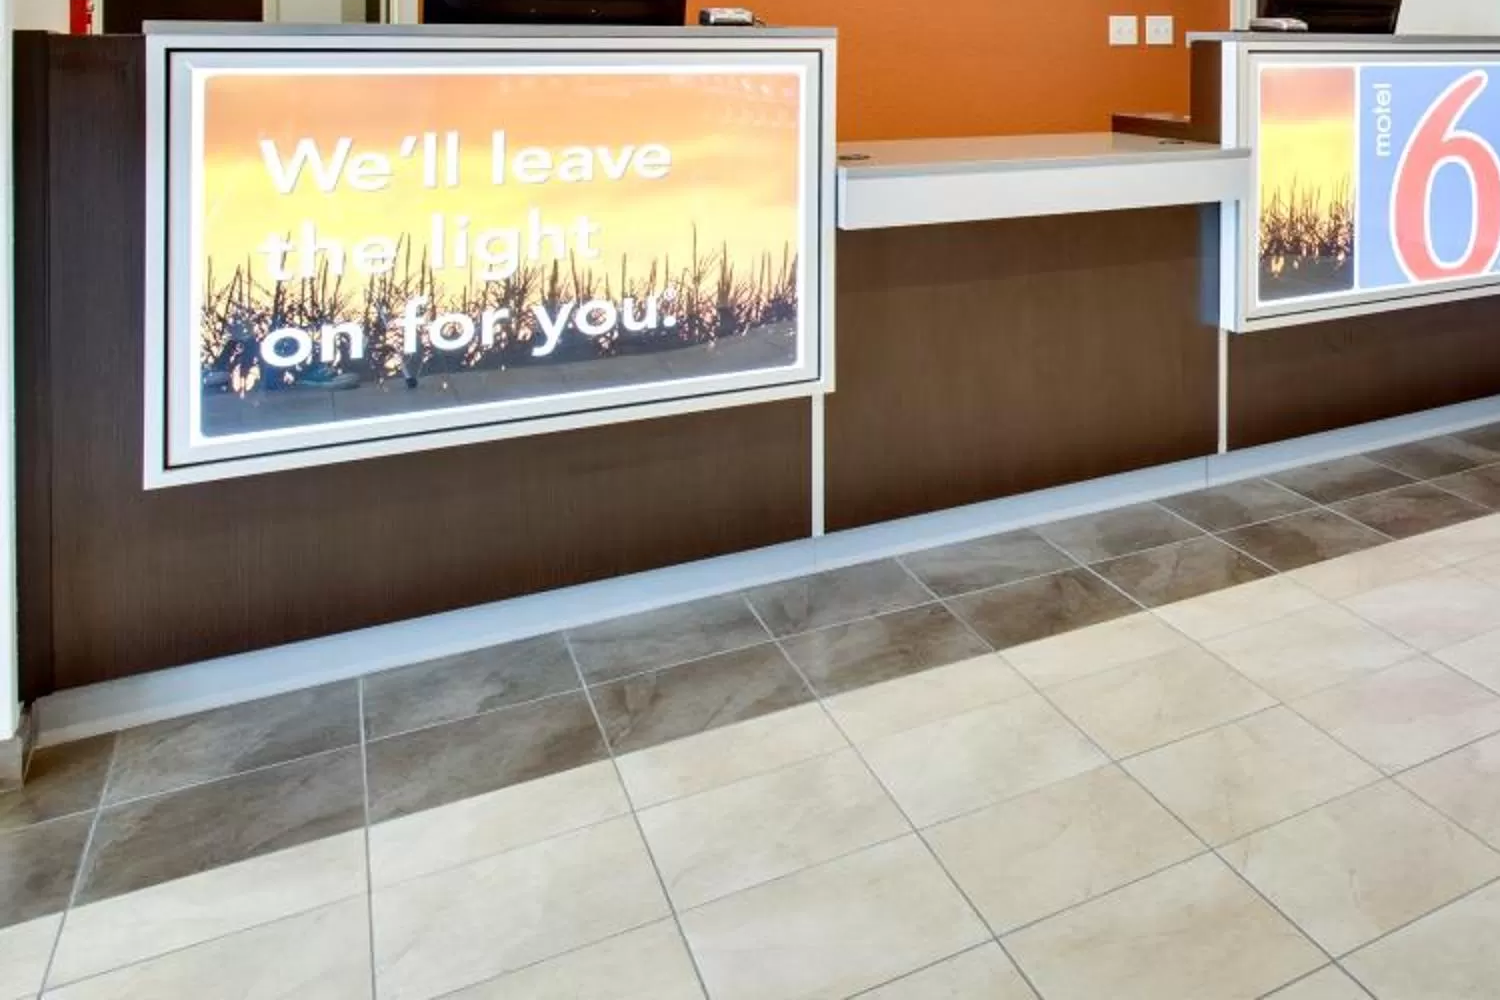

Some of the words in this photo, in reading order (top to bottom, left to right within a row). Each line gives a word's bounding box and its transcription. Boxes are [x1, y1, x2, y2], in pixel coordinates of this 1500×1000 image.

[1373, 83, 1392, 158] motel
[259, 131, 461, 195] We'll
[491, 130, 673, 186] leave
[257, 221, 396, 282] the
[431, 207, 602, 281] light
[260, 319, 365, 368] on
[400, 296, 511, 355] for
